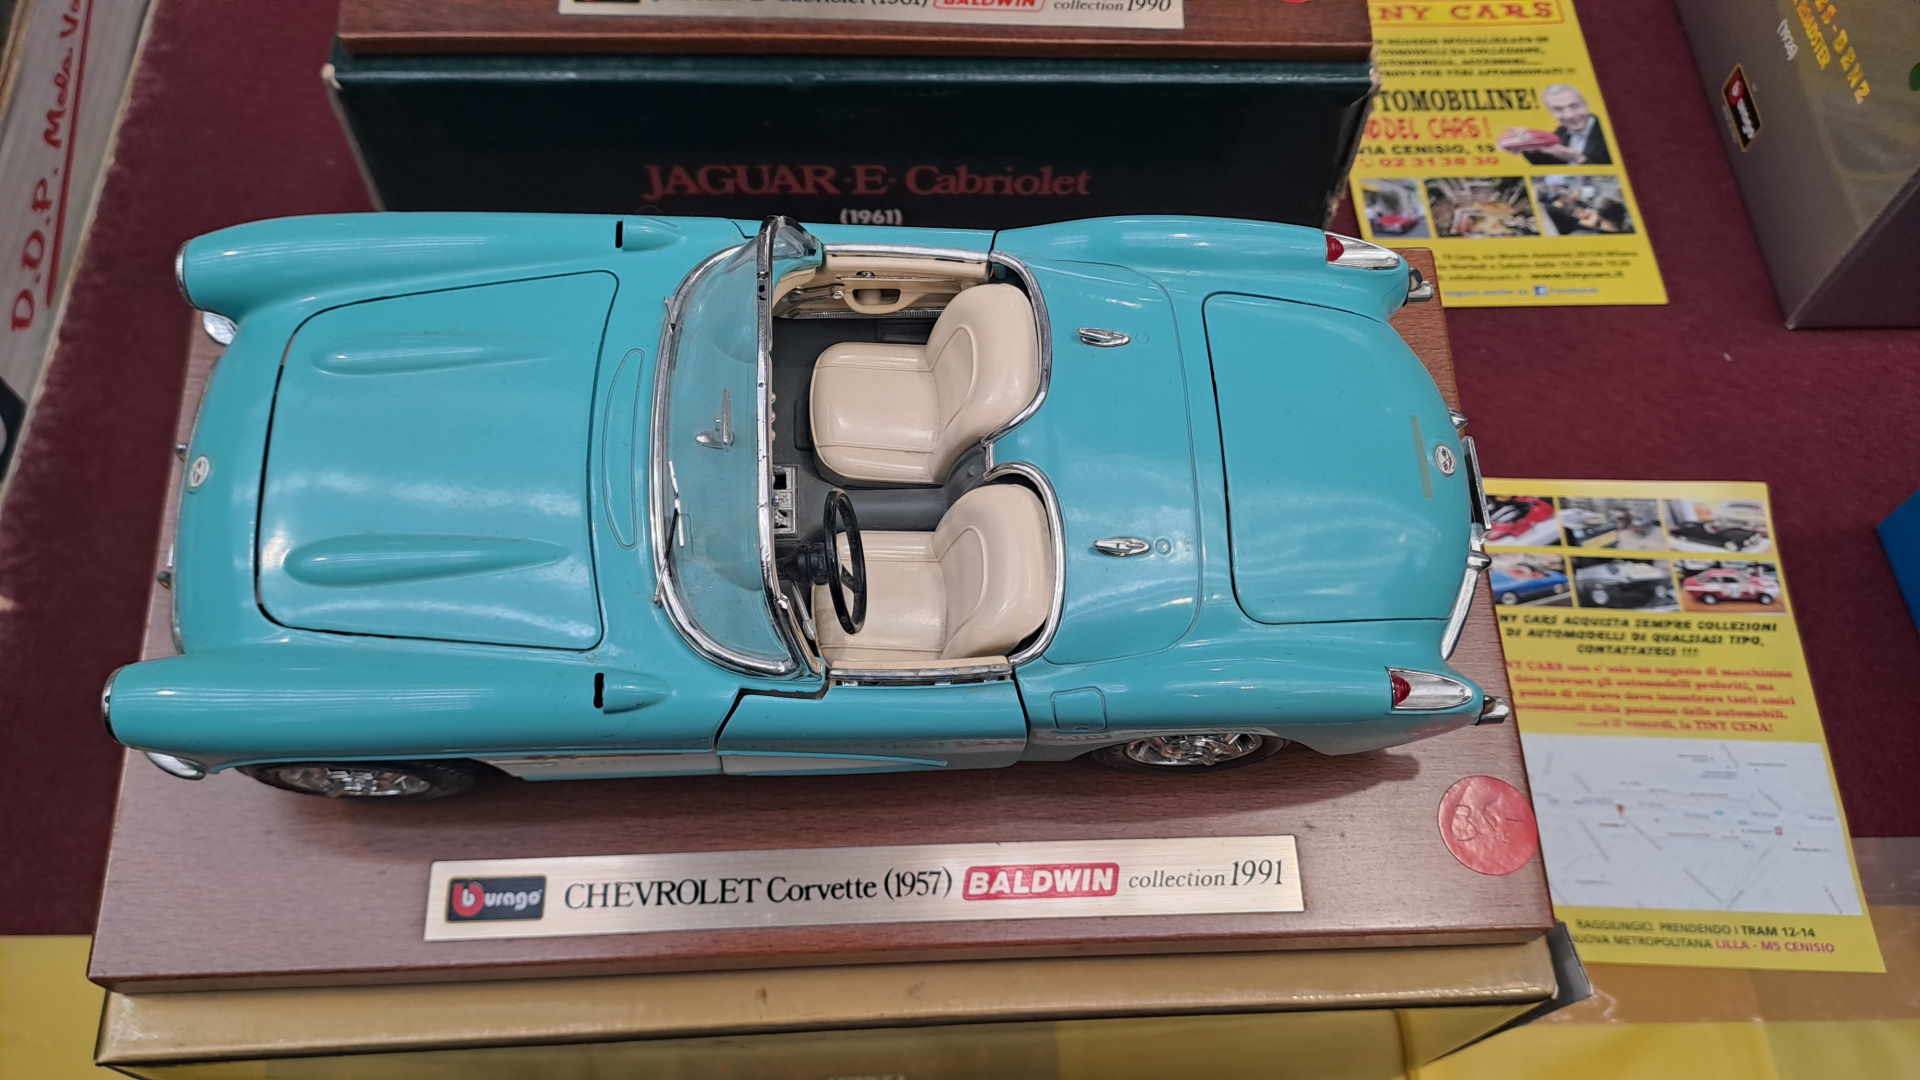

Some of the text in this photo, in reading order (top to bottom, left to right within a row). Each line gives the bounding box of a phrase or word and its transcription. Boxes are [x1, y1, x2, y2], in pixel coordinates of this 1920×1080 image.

[1450, 2, 1553, 20] CARS
[1375, 88, 1540, 111] TOMOBILINE!
[640, 163, 835, 200] JAGUAR
[905, 163, 1092, 195] Cabriolet
[840, 208, 902, 226] (1961)
[1523, 614, 1557, 625] CARS
[1563, 616, 1630, 628] ACQUISTA
[1698, 621, 1778, 632] COLLEZIONI
[1527, 629, 1625, 641] AUTOMODELLI
[564, 877, 762, 909] CHEVROLET
[767, 876, 877, 902] Corvette
[884, 866, 953, 902] (1957)
[968, 867, 1113, 895] BALDWIN
[1128, 868, 1225, 888] collection
[1231, 859, 1283, 886] 1991
[1741, 924, 1778, 937] TRAM
[1614, 936, 1712, 949] METROPOLITANA
[1784, 942, 1836, 954] CENISIO
